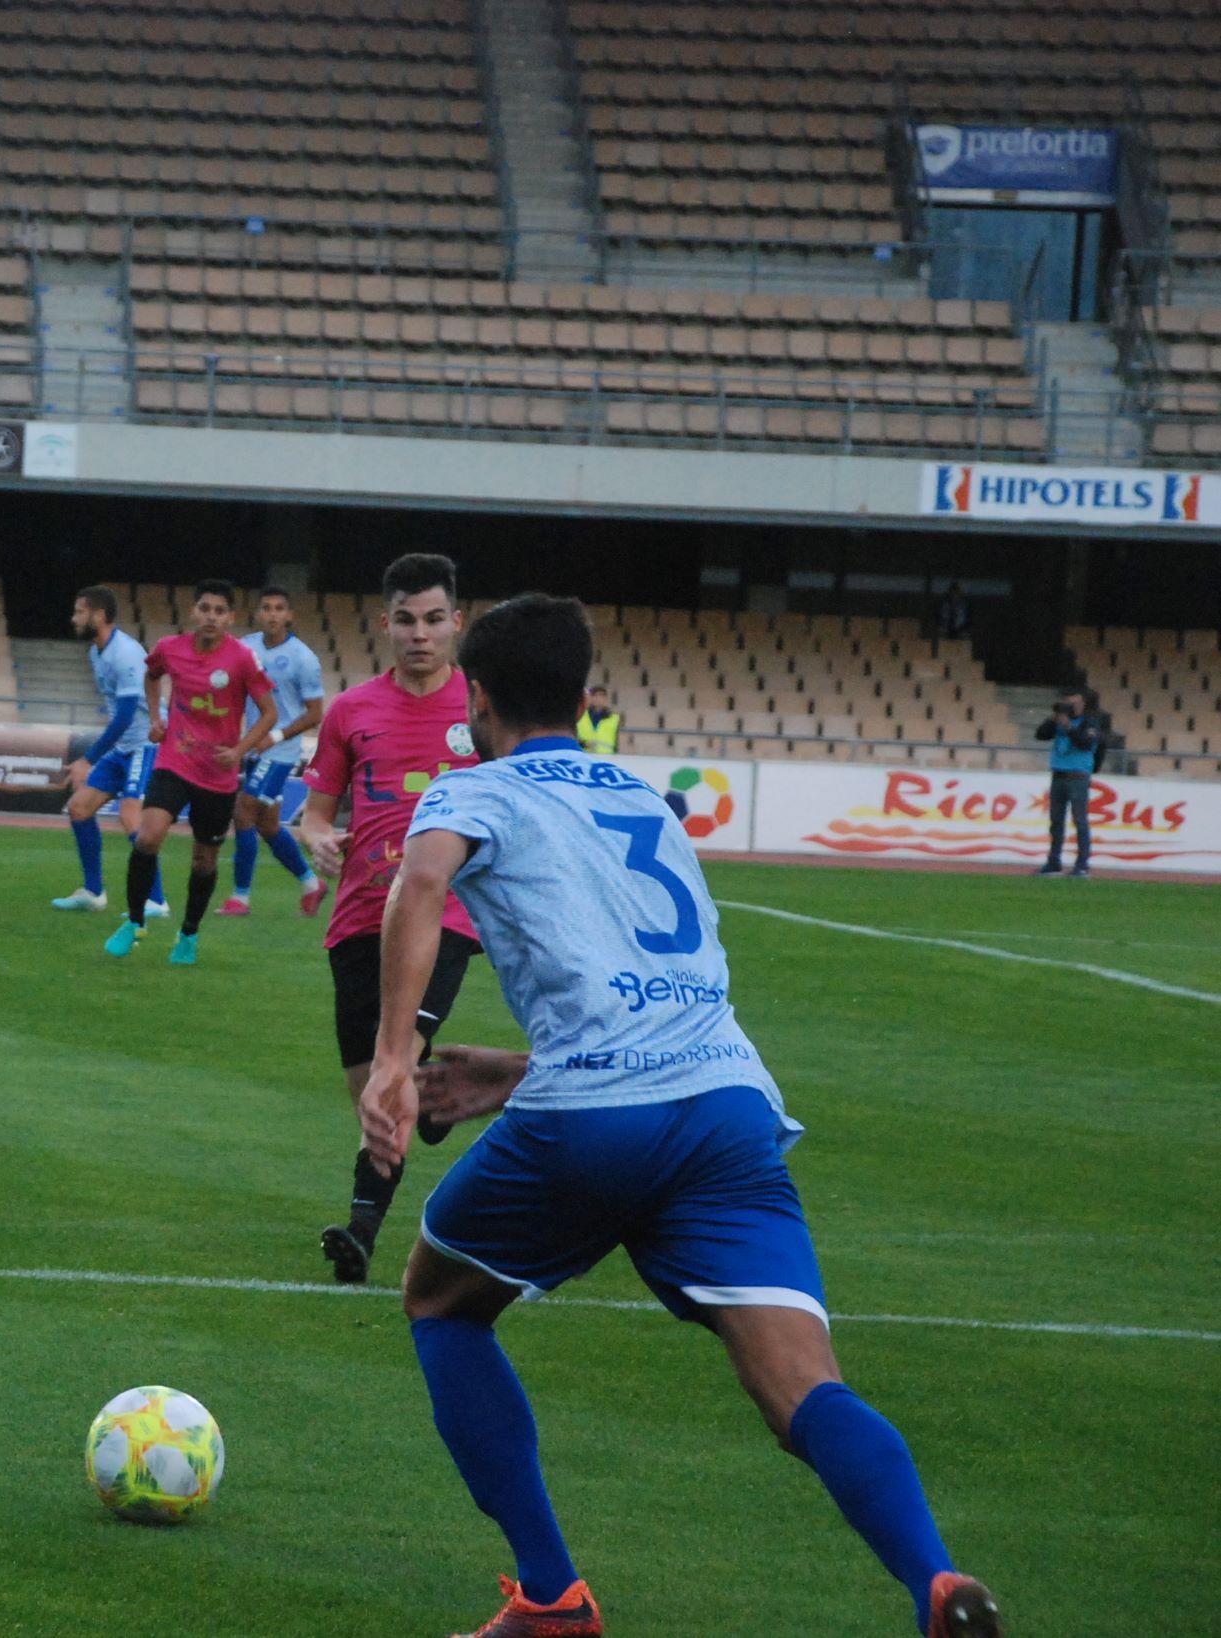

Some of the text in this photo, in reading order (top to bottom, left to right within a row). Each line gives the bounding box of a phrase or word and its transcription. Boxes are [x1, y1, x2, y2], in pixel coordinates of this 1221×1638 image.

[966, 127, 1109, 160] prefortia
[980, 475, 1153, 509] HIPOTELS
[884, 771, 1187, 831] Rico Bus
[589, 810, 702, 954] 3
